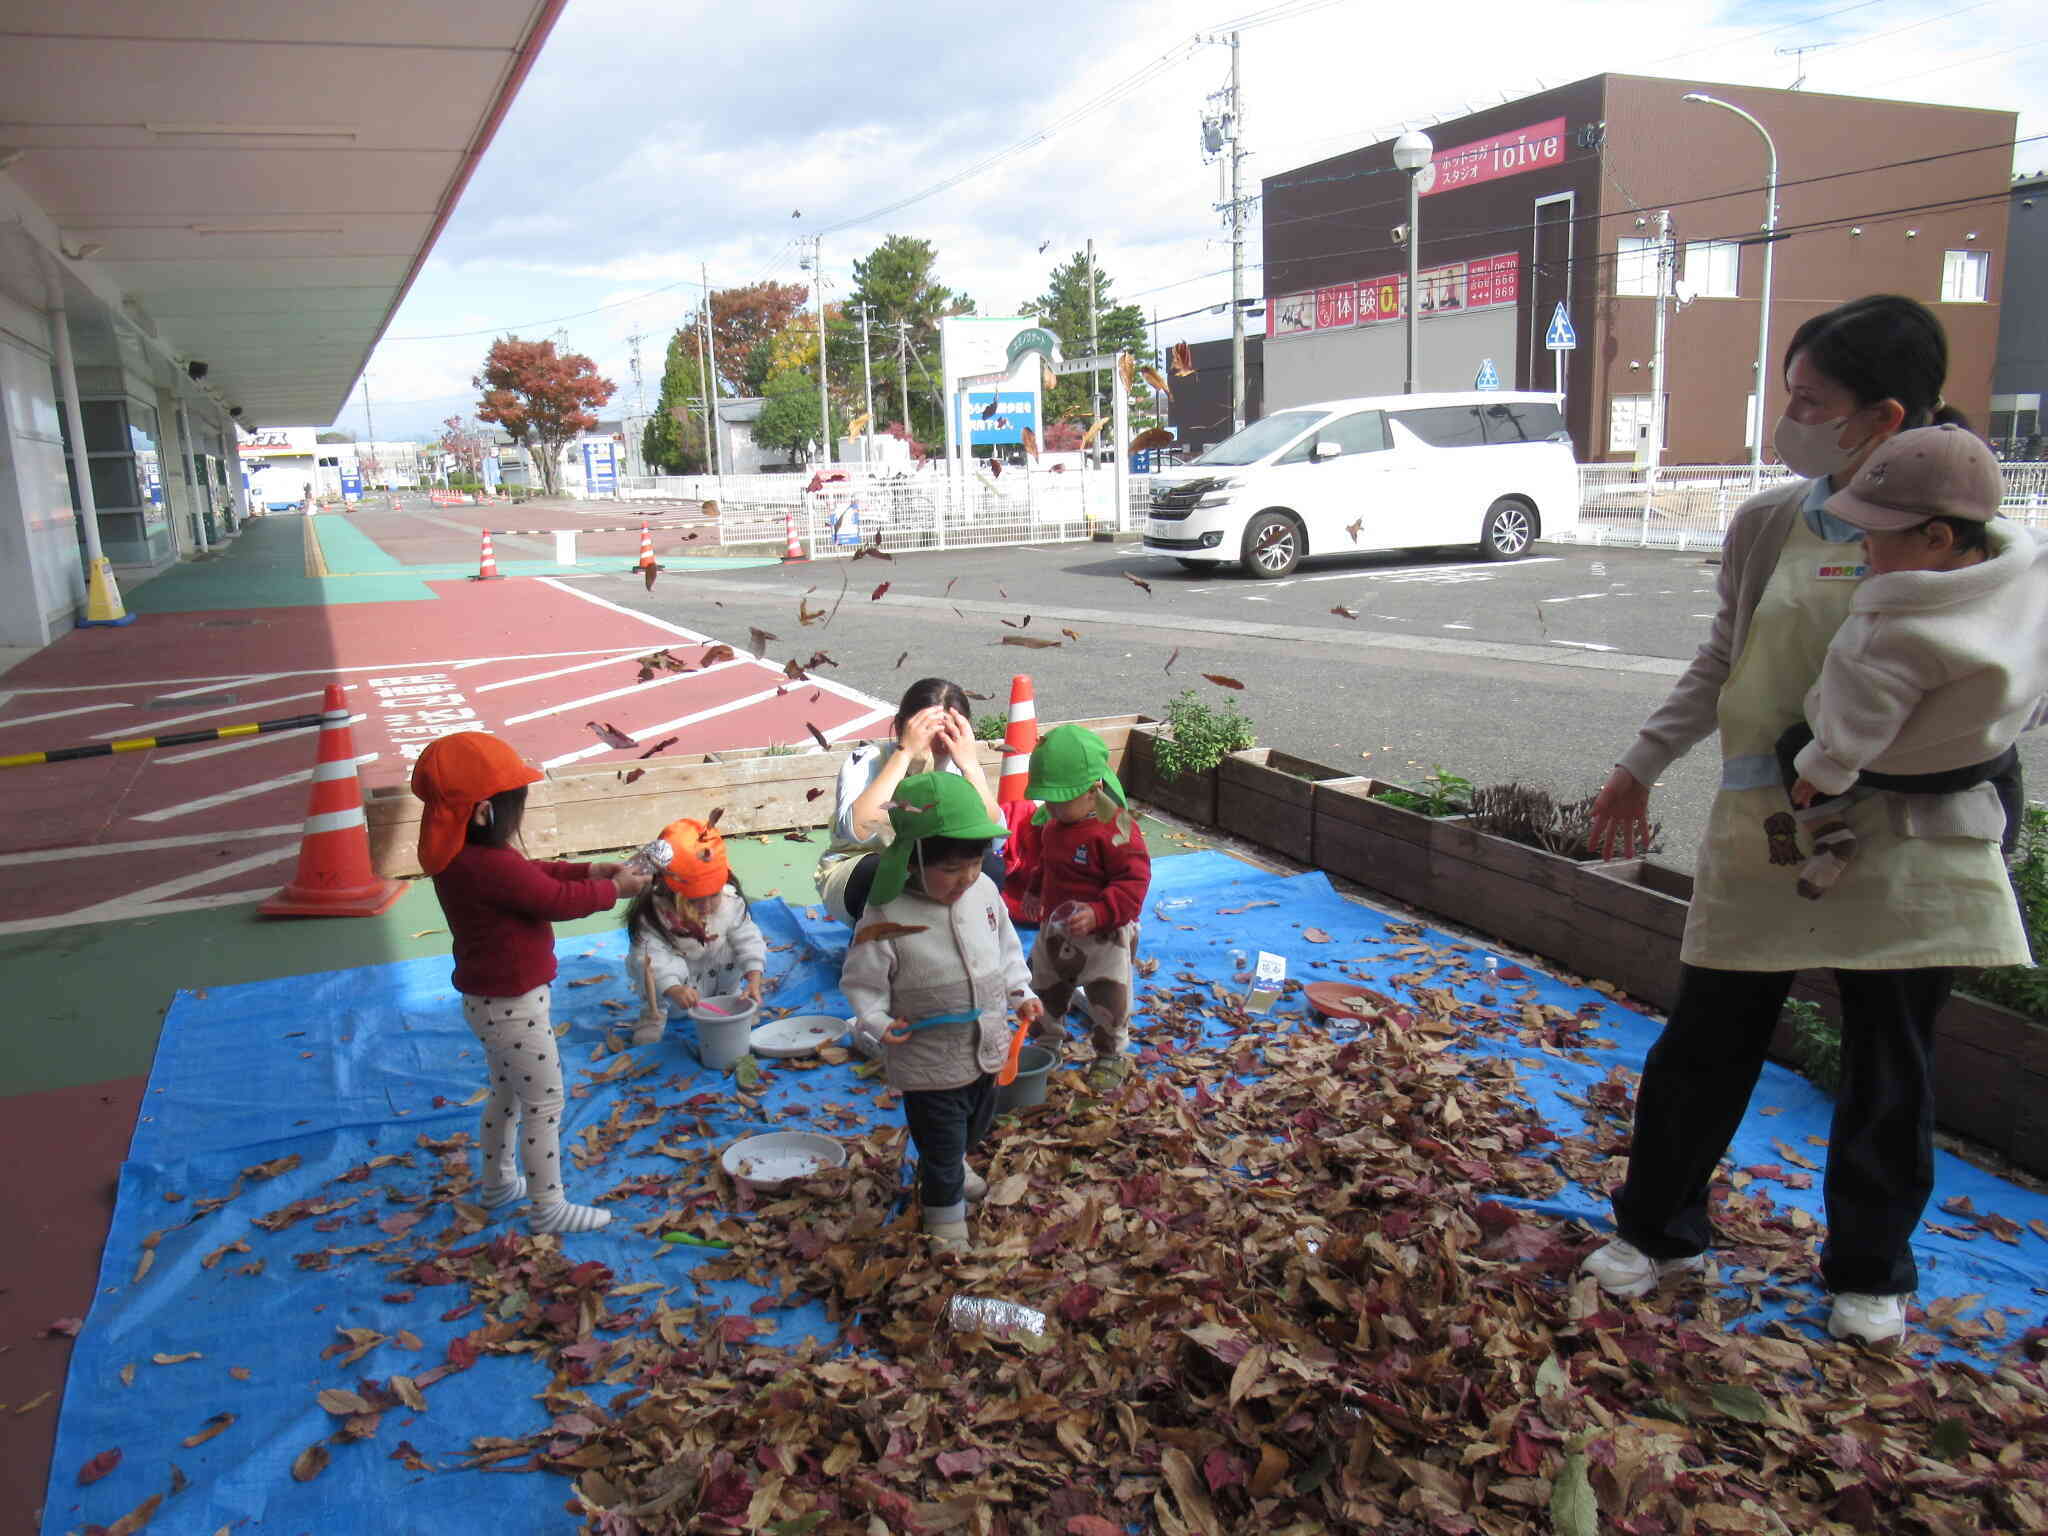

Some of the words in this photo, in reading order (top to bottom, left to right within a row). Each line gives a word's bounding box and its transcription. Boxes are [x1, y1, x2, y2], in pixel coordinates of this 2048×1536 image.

[1440, 145, 1489, 170] ホットヨガ
[1442, 165, 1479, 185] スタジオ
